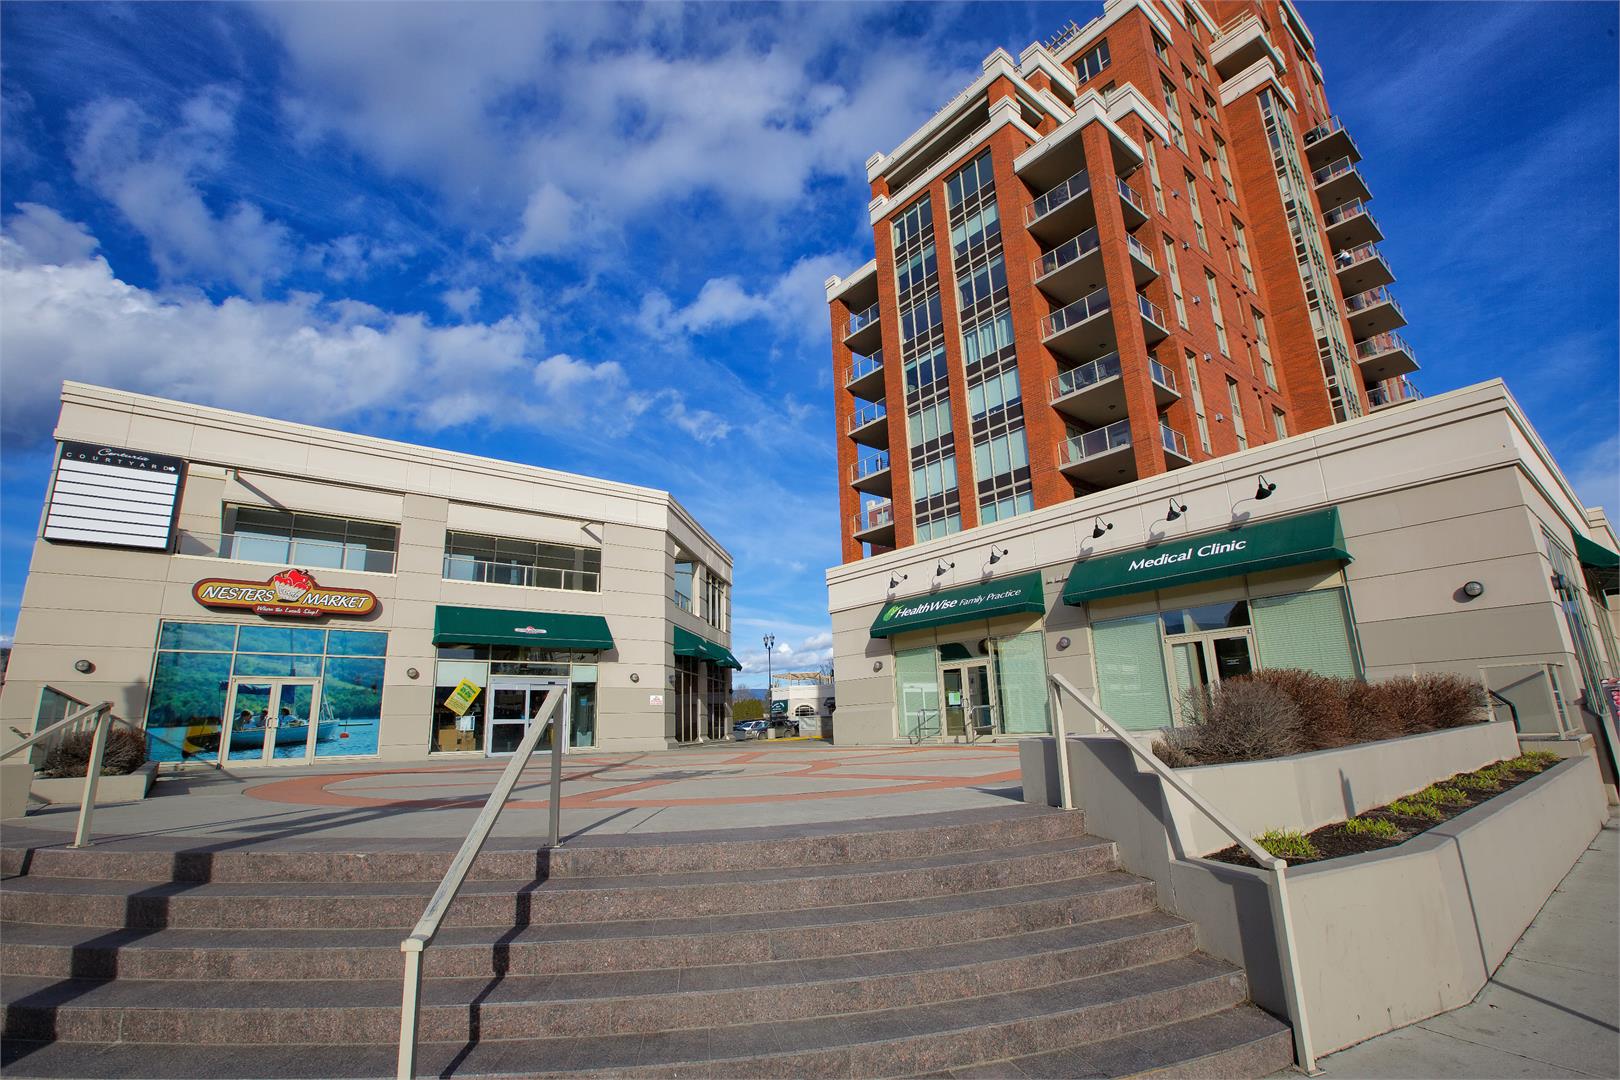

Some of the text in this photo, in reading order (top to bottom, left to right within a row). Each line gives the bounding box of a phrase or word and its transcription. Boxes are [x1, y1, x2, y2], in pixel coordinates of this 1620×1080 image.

[66, 452, 169, 470] COURTYARD
[1128, 540, 1247, 572] Medical Clinic
[201, 586, 275, 602] NESTERS
[302, 593, 369, 608] MARKET
[895, 588, 1022, 618] HealthWise Family Practice
